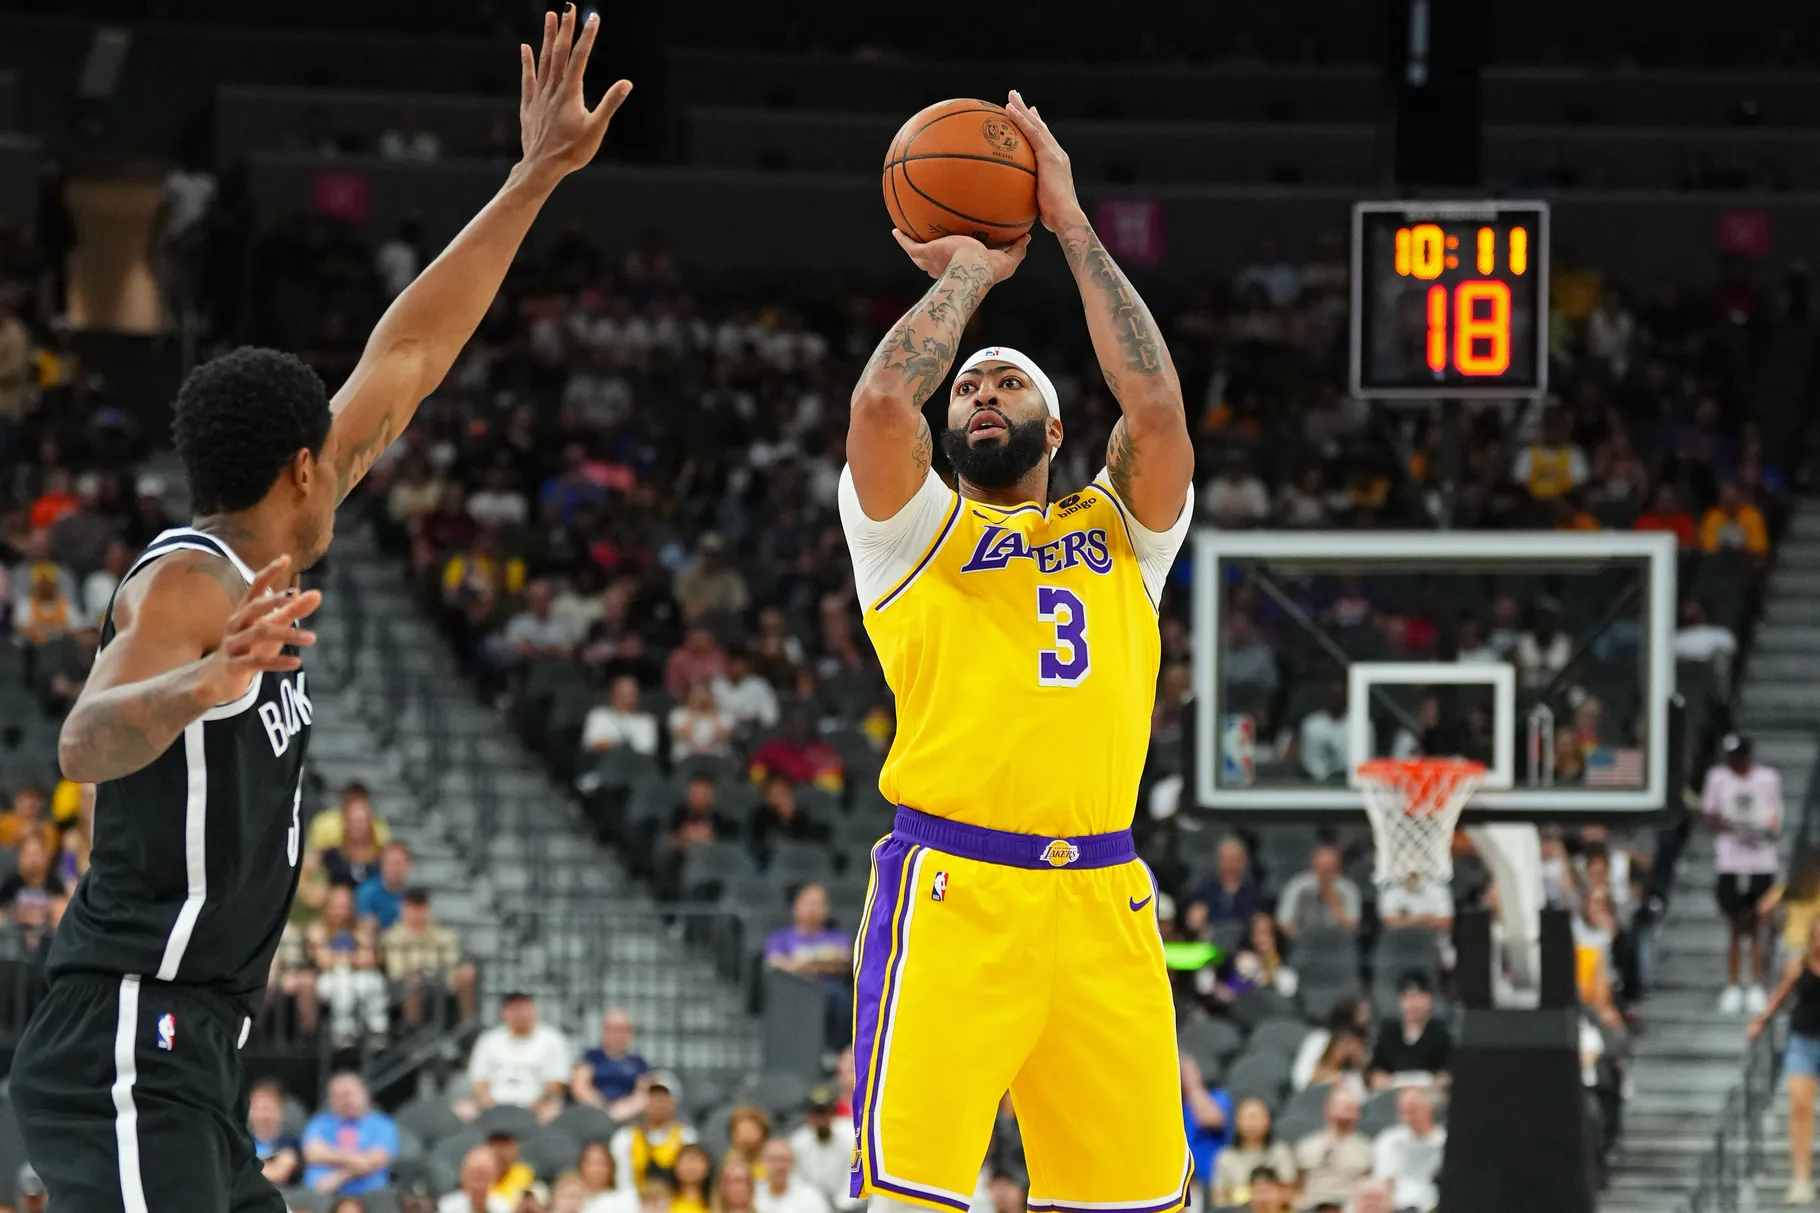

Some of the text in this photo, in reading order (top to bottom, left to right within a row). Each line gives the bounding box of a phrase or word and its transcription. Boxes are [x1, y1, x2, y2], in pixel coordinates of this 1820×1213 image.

[1426, 280, 1511, 376] 18
[1057, 497, 1097, 518] bibigo
[960, 525, 1112, 575] LAERS
[1036, 584, 1091, 688] 3
[1041, 846, 1078, 861] LAKERS
